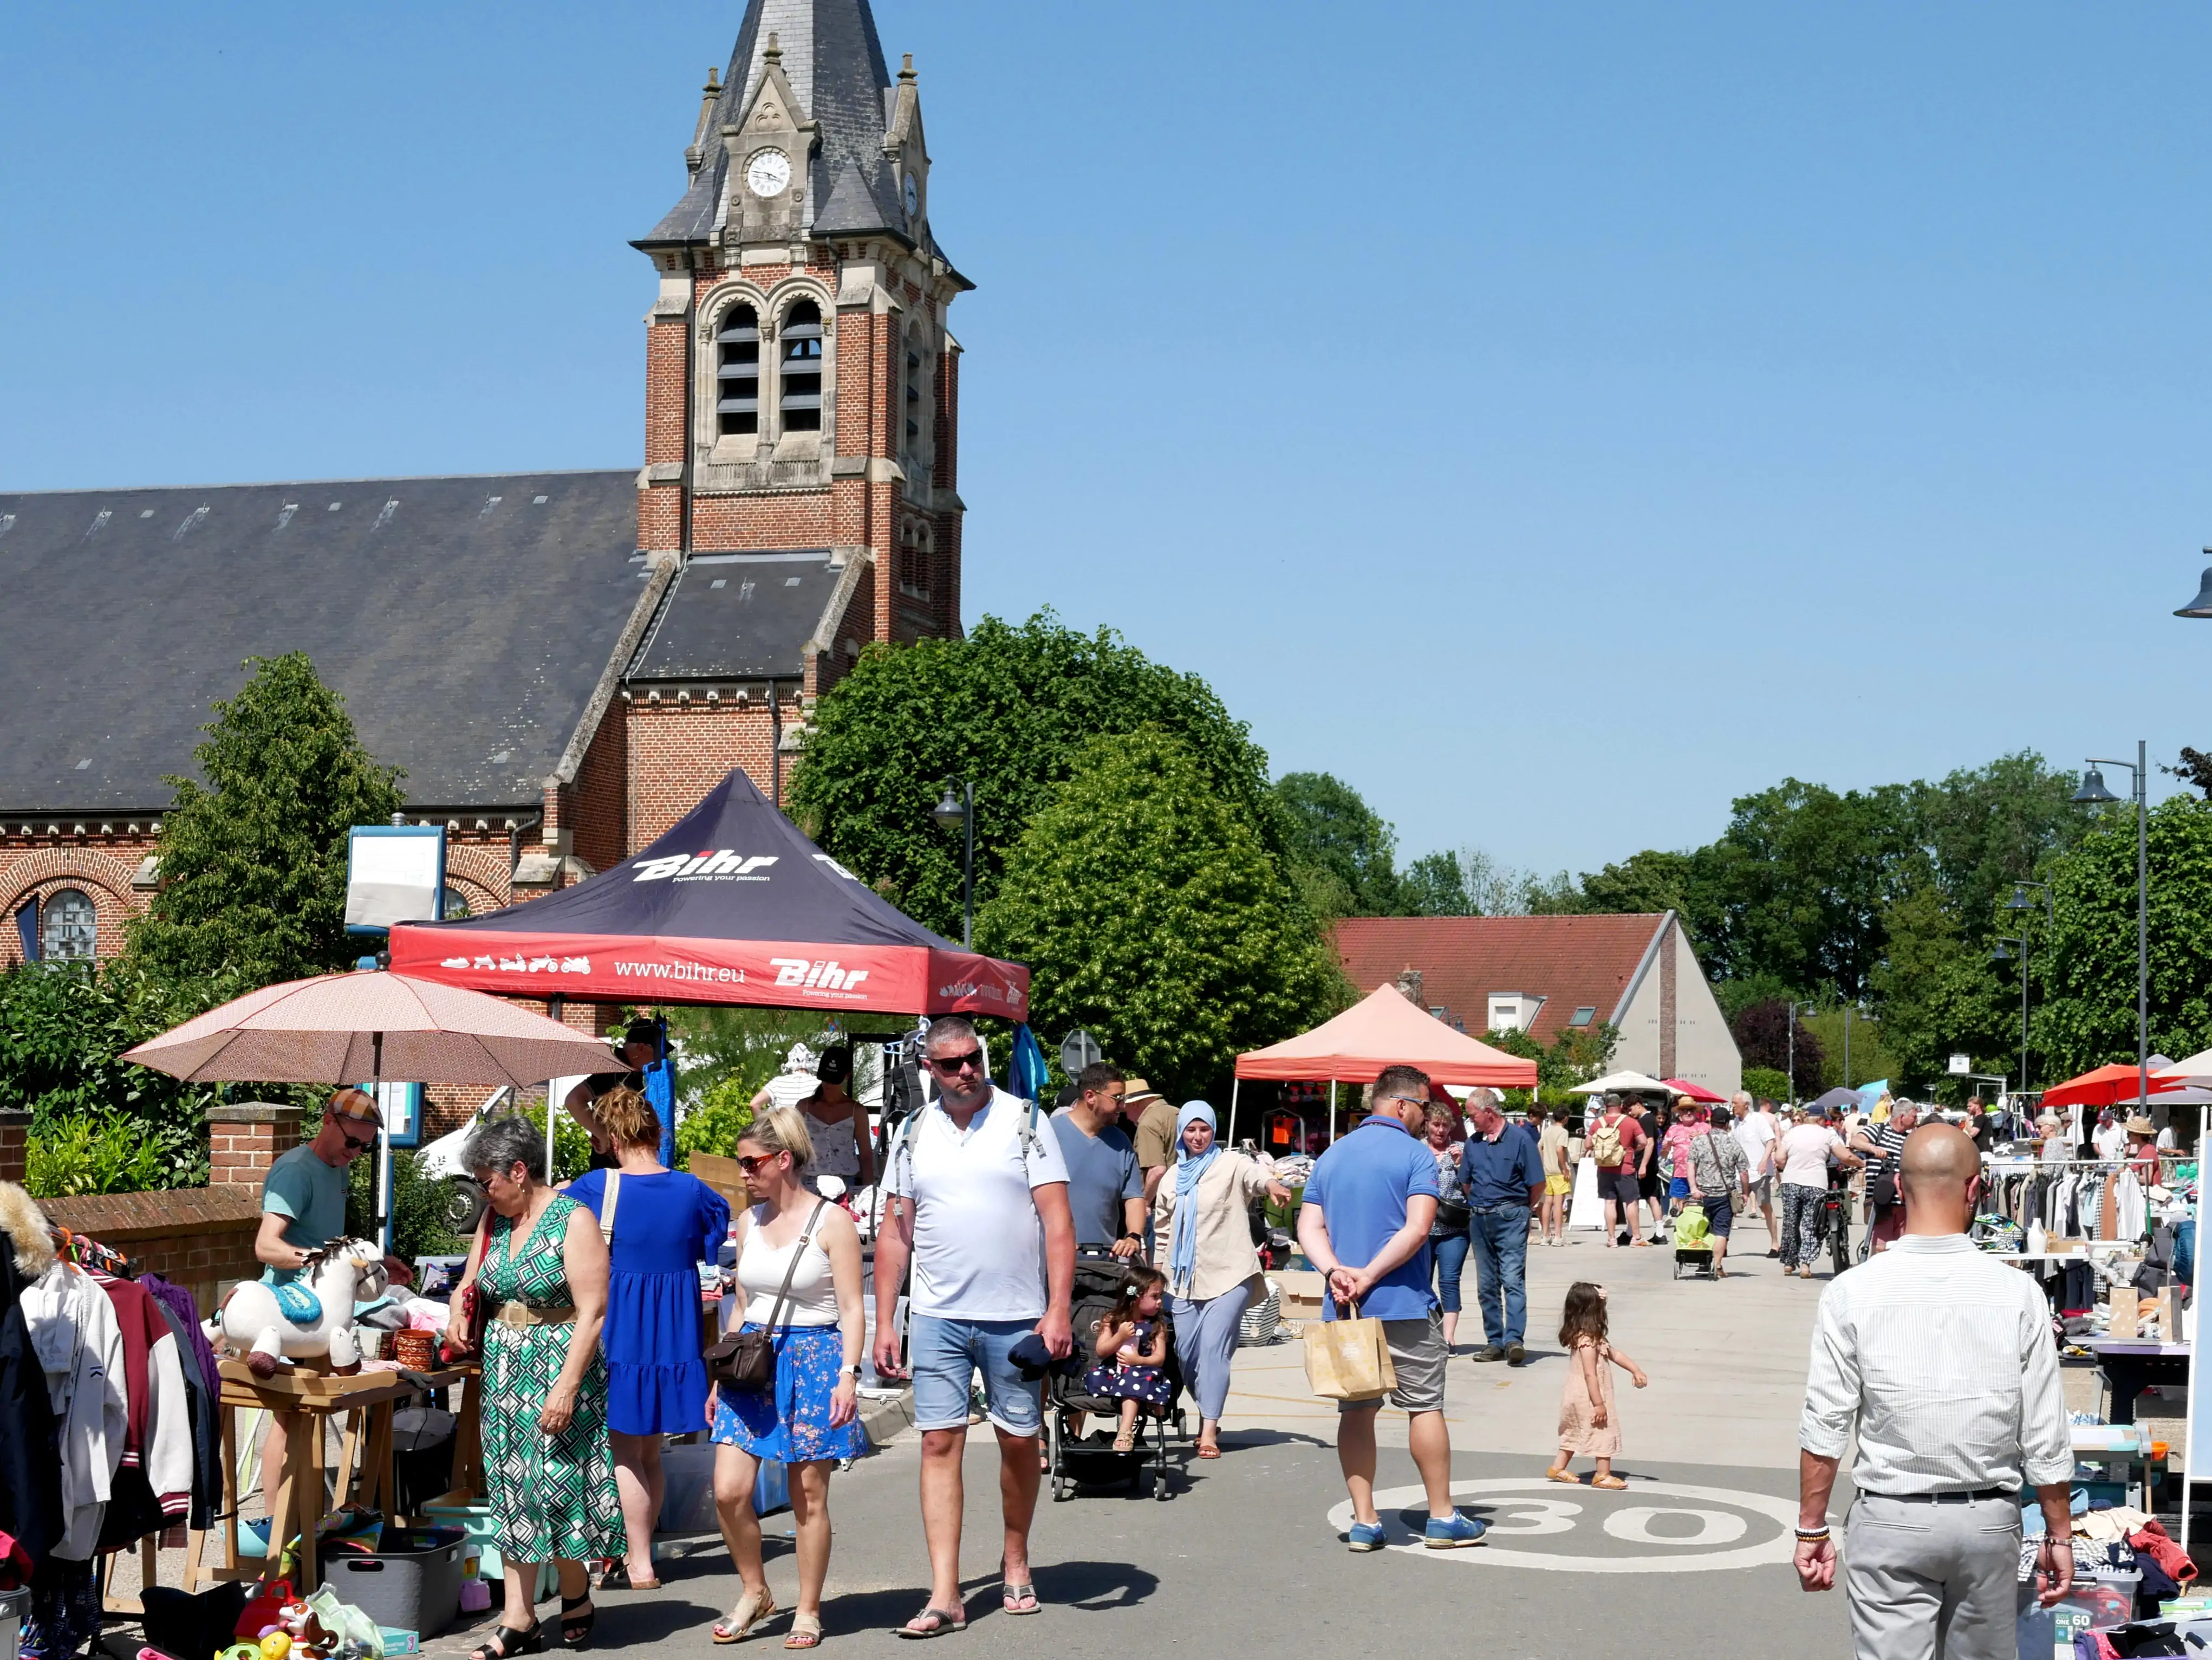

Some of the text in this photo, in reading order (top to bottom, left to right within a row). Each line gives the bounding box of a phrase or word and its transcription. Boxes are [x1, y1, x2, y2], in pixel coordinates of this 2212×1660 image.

[632, 850, 779, 882] Bihr
[672, 874, 712, 883] Powering
[614, 961, 745, 983] www.bihr.eu
[770, 957, 869, 990] Bihr
[802, 989, 830, 998] Powering
[1471, 1497, 1748, 1545] 30
[2072, 1614, 2090, 1626] 60
